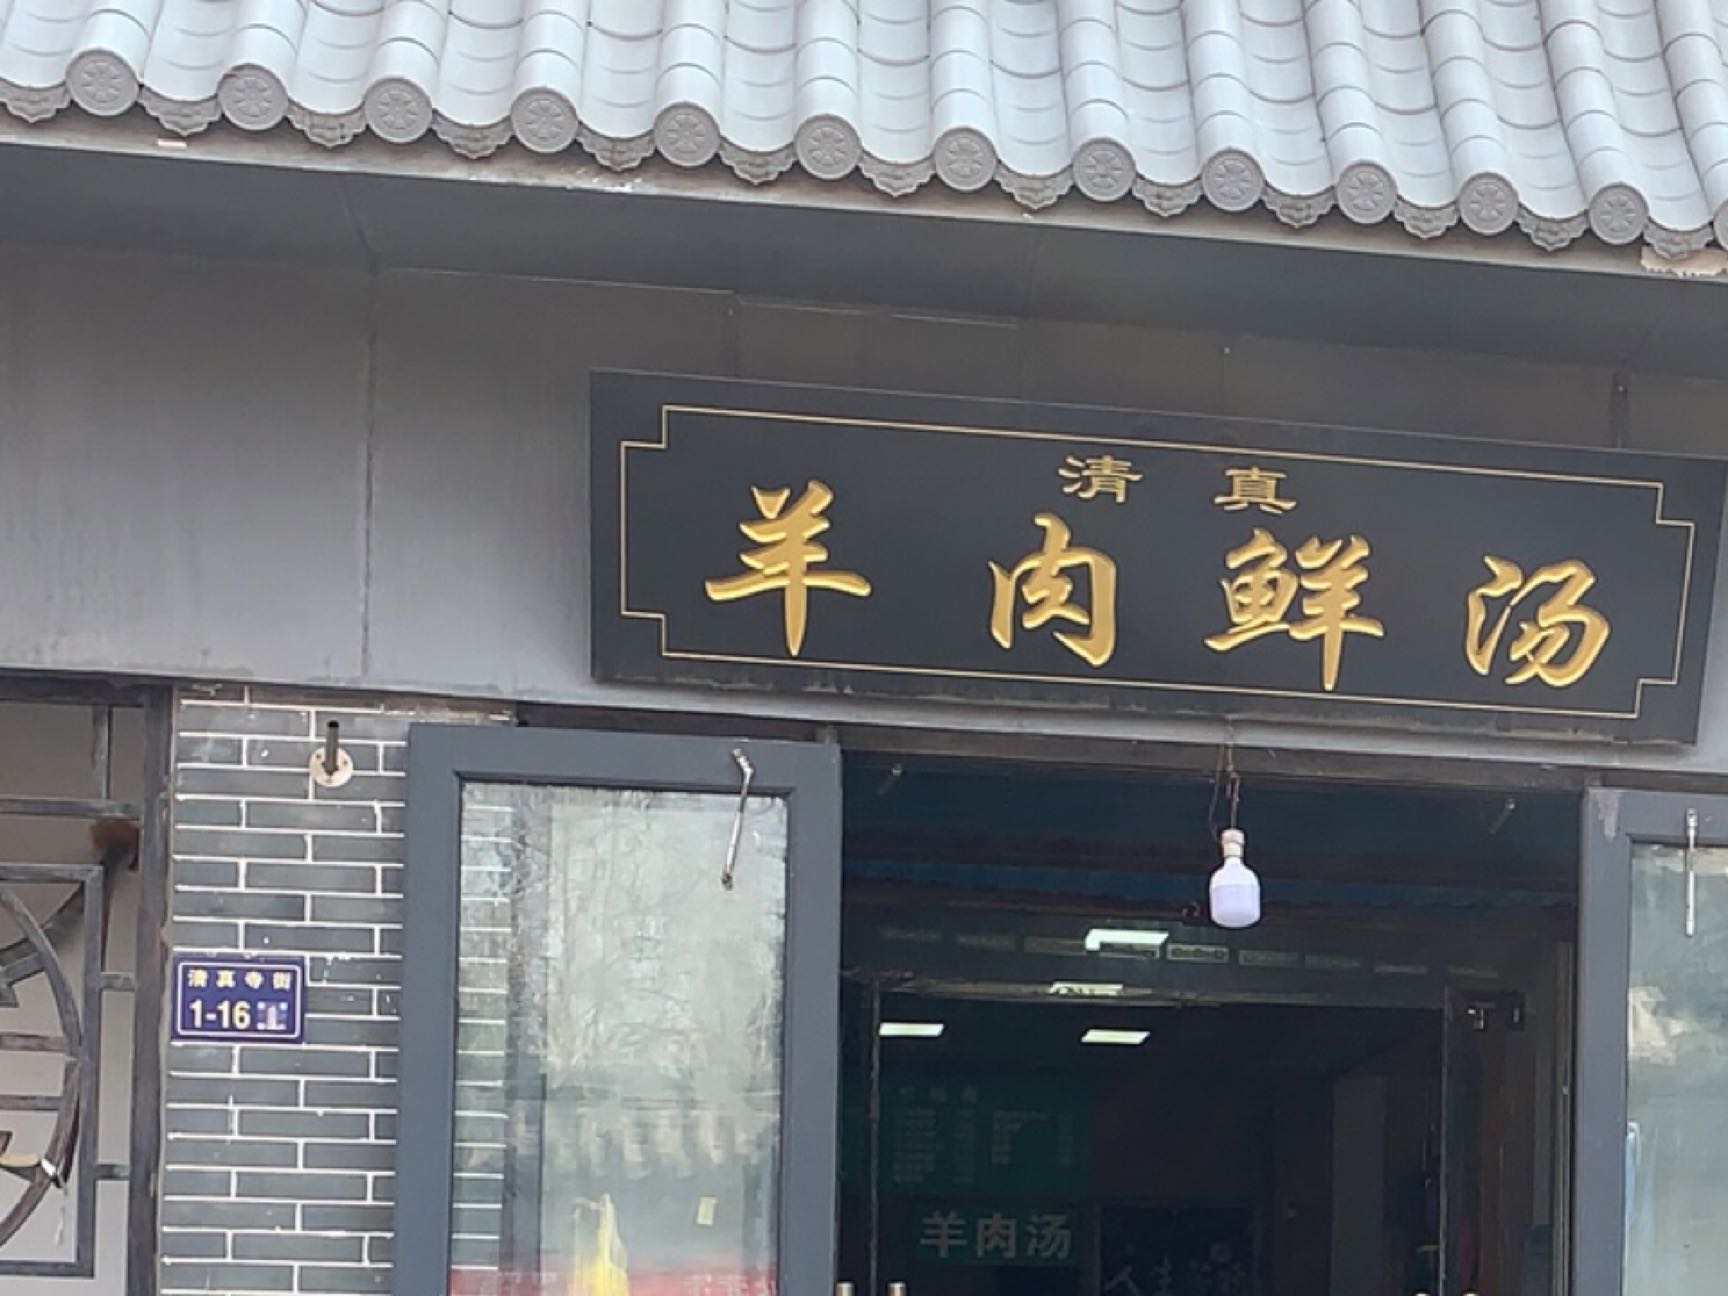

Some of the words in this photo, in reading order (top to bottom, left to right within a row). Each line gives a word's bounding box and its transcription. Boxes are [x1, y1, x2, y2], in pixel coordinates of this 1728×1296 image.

[1057, 454, 1298, 516] 清真
[704, 478, 1612, 692] 羊肉鲜汤
[189, 999, 251, 1030] 1-16
[919, 1209, 1073, 1261] 羊肉汤
